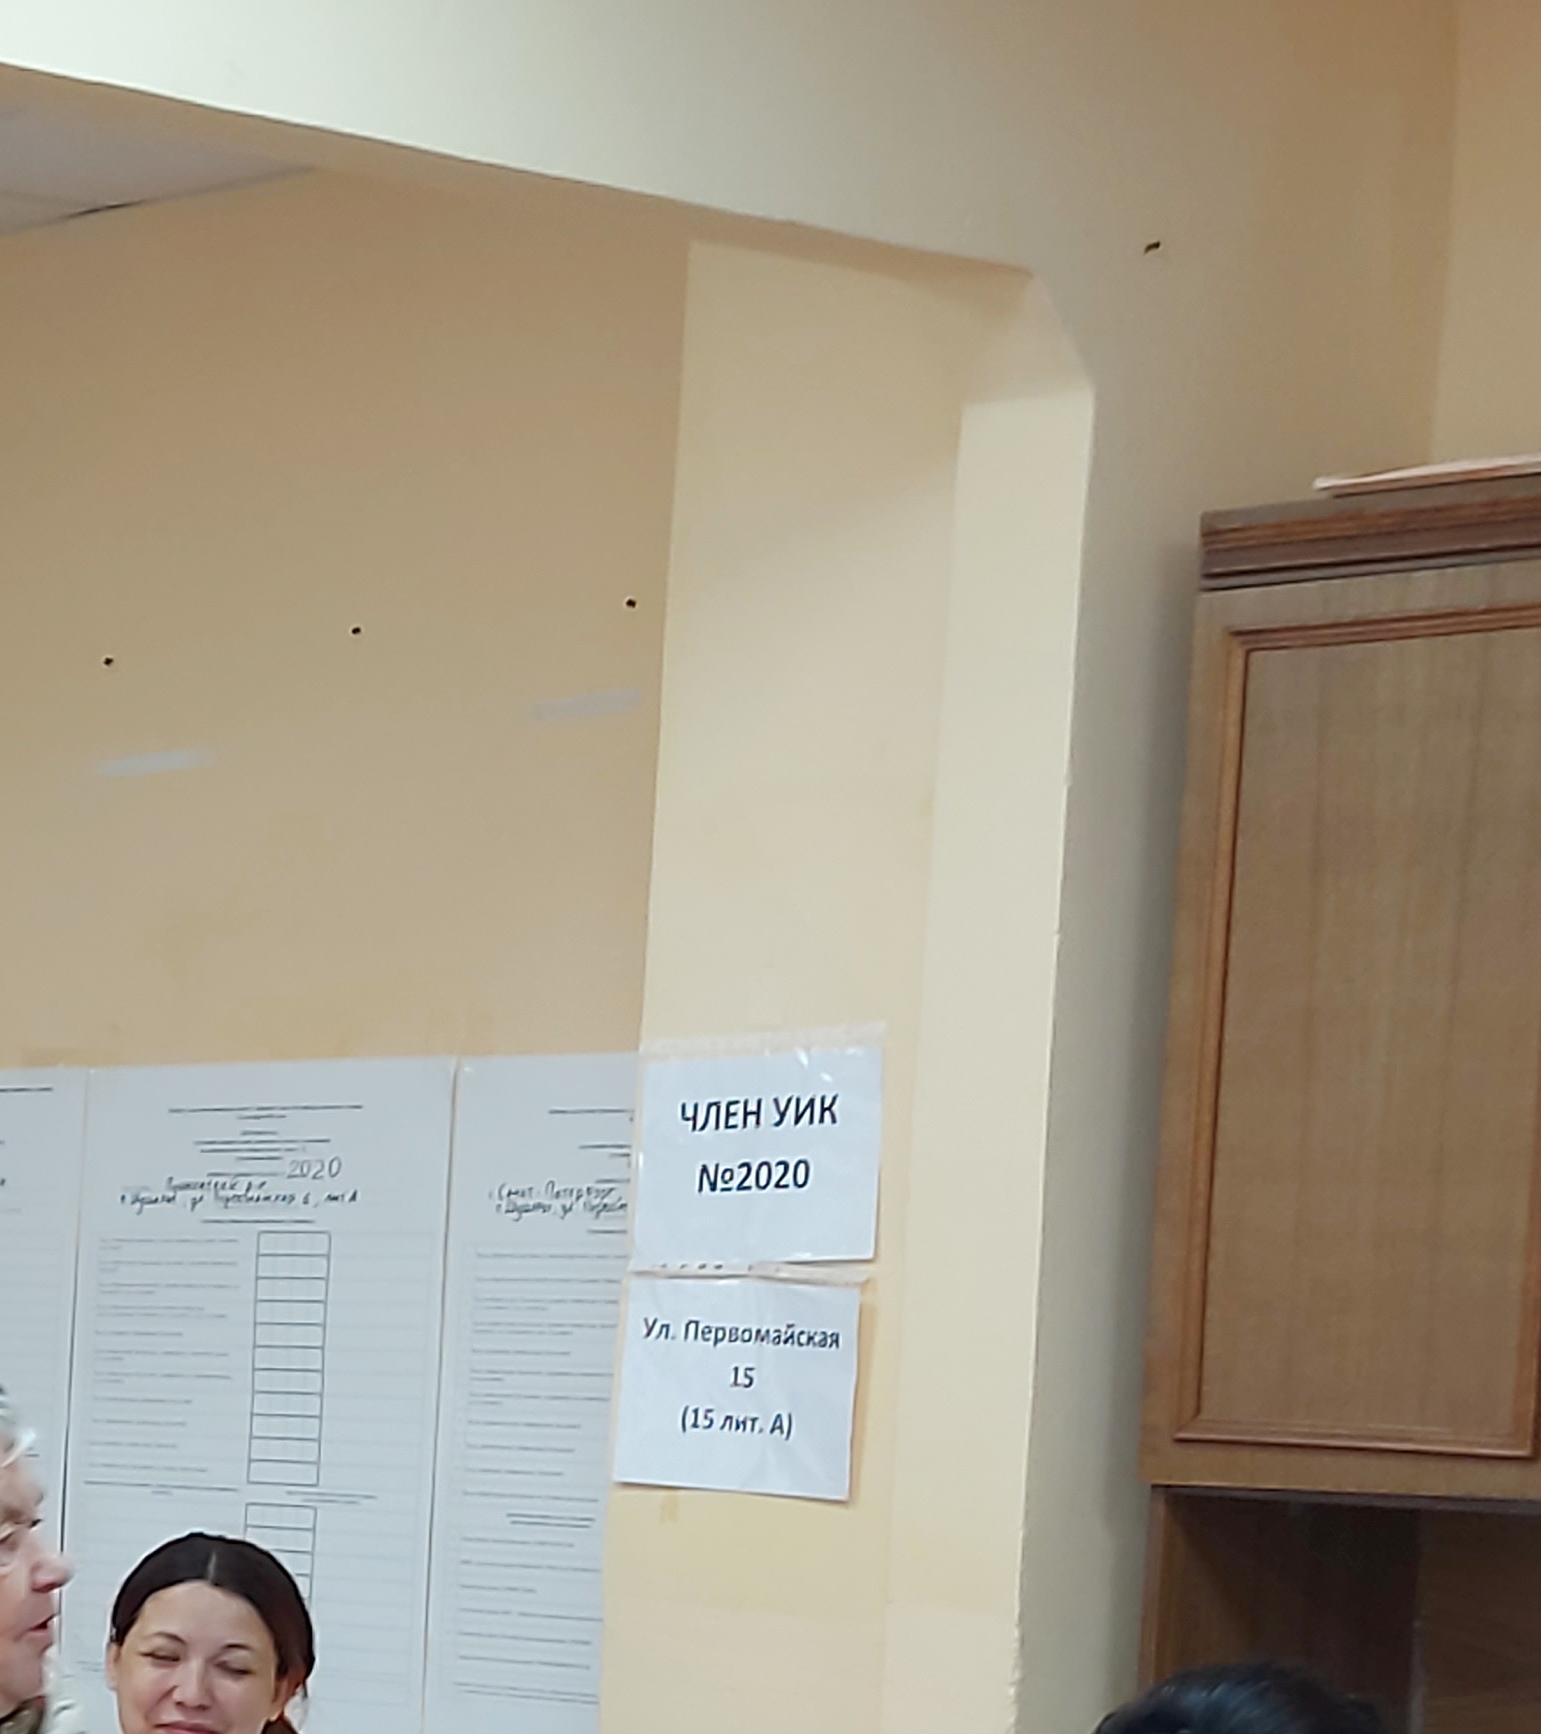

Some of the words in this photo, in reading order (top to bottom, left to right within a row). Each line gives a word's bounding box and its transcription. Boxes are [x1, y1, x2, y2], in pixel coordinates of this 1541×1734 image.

[681, 1098, 763, 1132] ЧЛЕН
[772, 1093, 839, 1128] УИК
[287, 1156, 343, 1180] 2020
[698, 1158, 811, 1194] №2020
[643, 1317, 677, 1341] Ул.
[683, 1319, 841, 1350] Первомайская
[729, 1365, 756, 1389] 15
[681, 1404, 715, 1434] (15
[719, 1414, 764, 1434] лит.
[769, 1412, 793, 1441] А)
